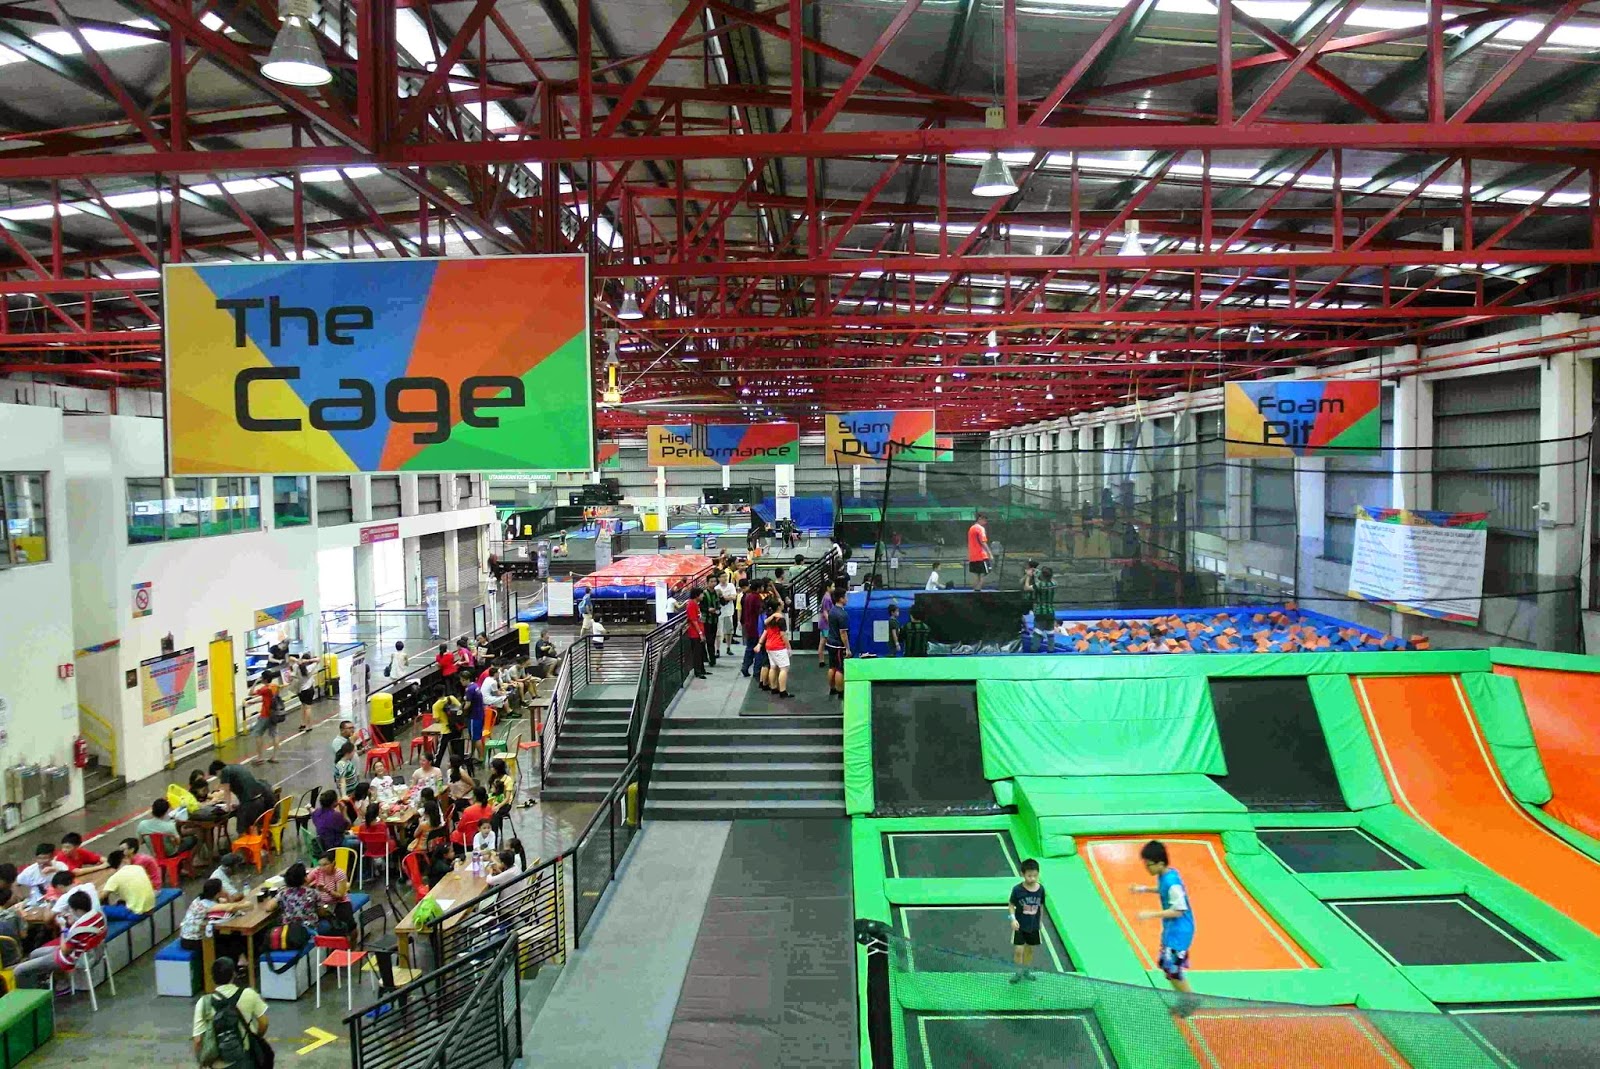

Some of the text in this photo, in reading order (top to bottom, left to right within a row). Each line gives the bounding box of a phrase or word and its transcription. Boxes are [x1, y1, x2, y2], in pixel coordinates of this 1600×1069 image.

[216, 296, 374, 348] The
[234, 366, 526, 445] Cage
[1257, 396, 1345, 415] Foam
[838, 421, 891, 434] Slam
[1263, 419, 1315, 446] Pit
[842, 437, 917, 455] Dunk
